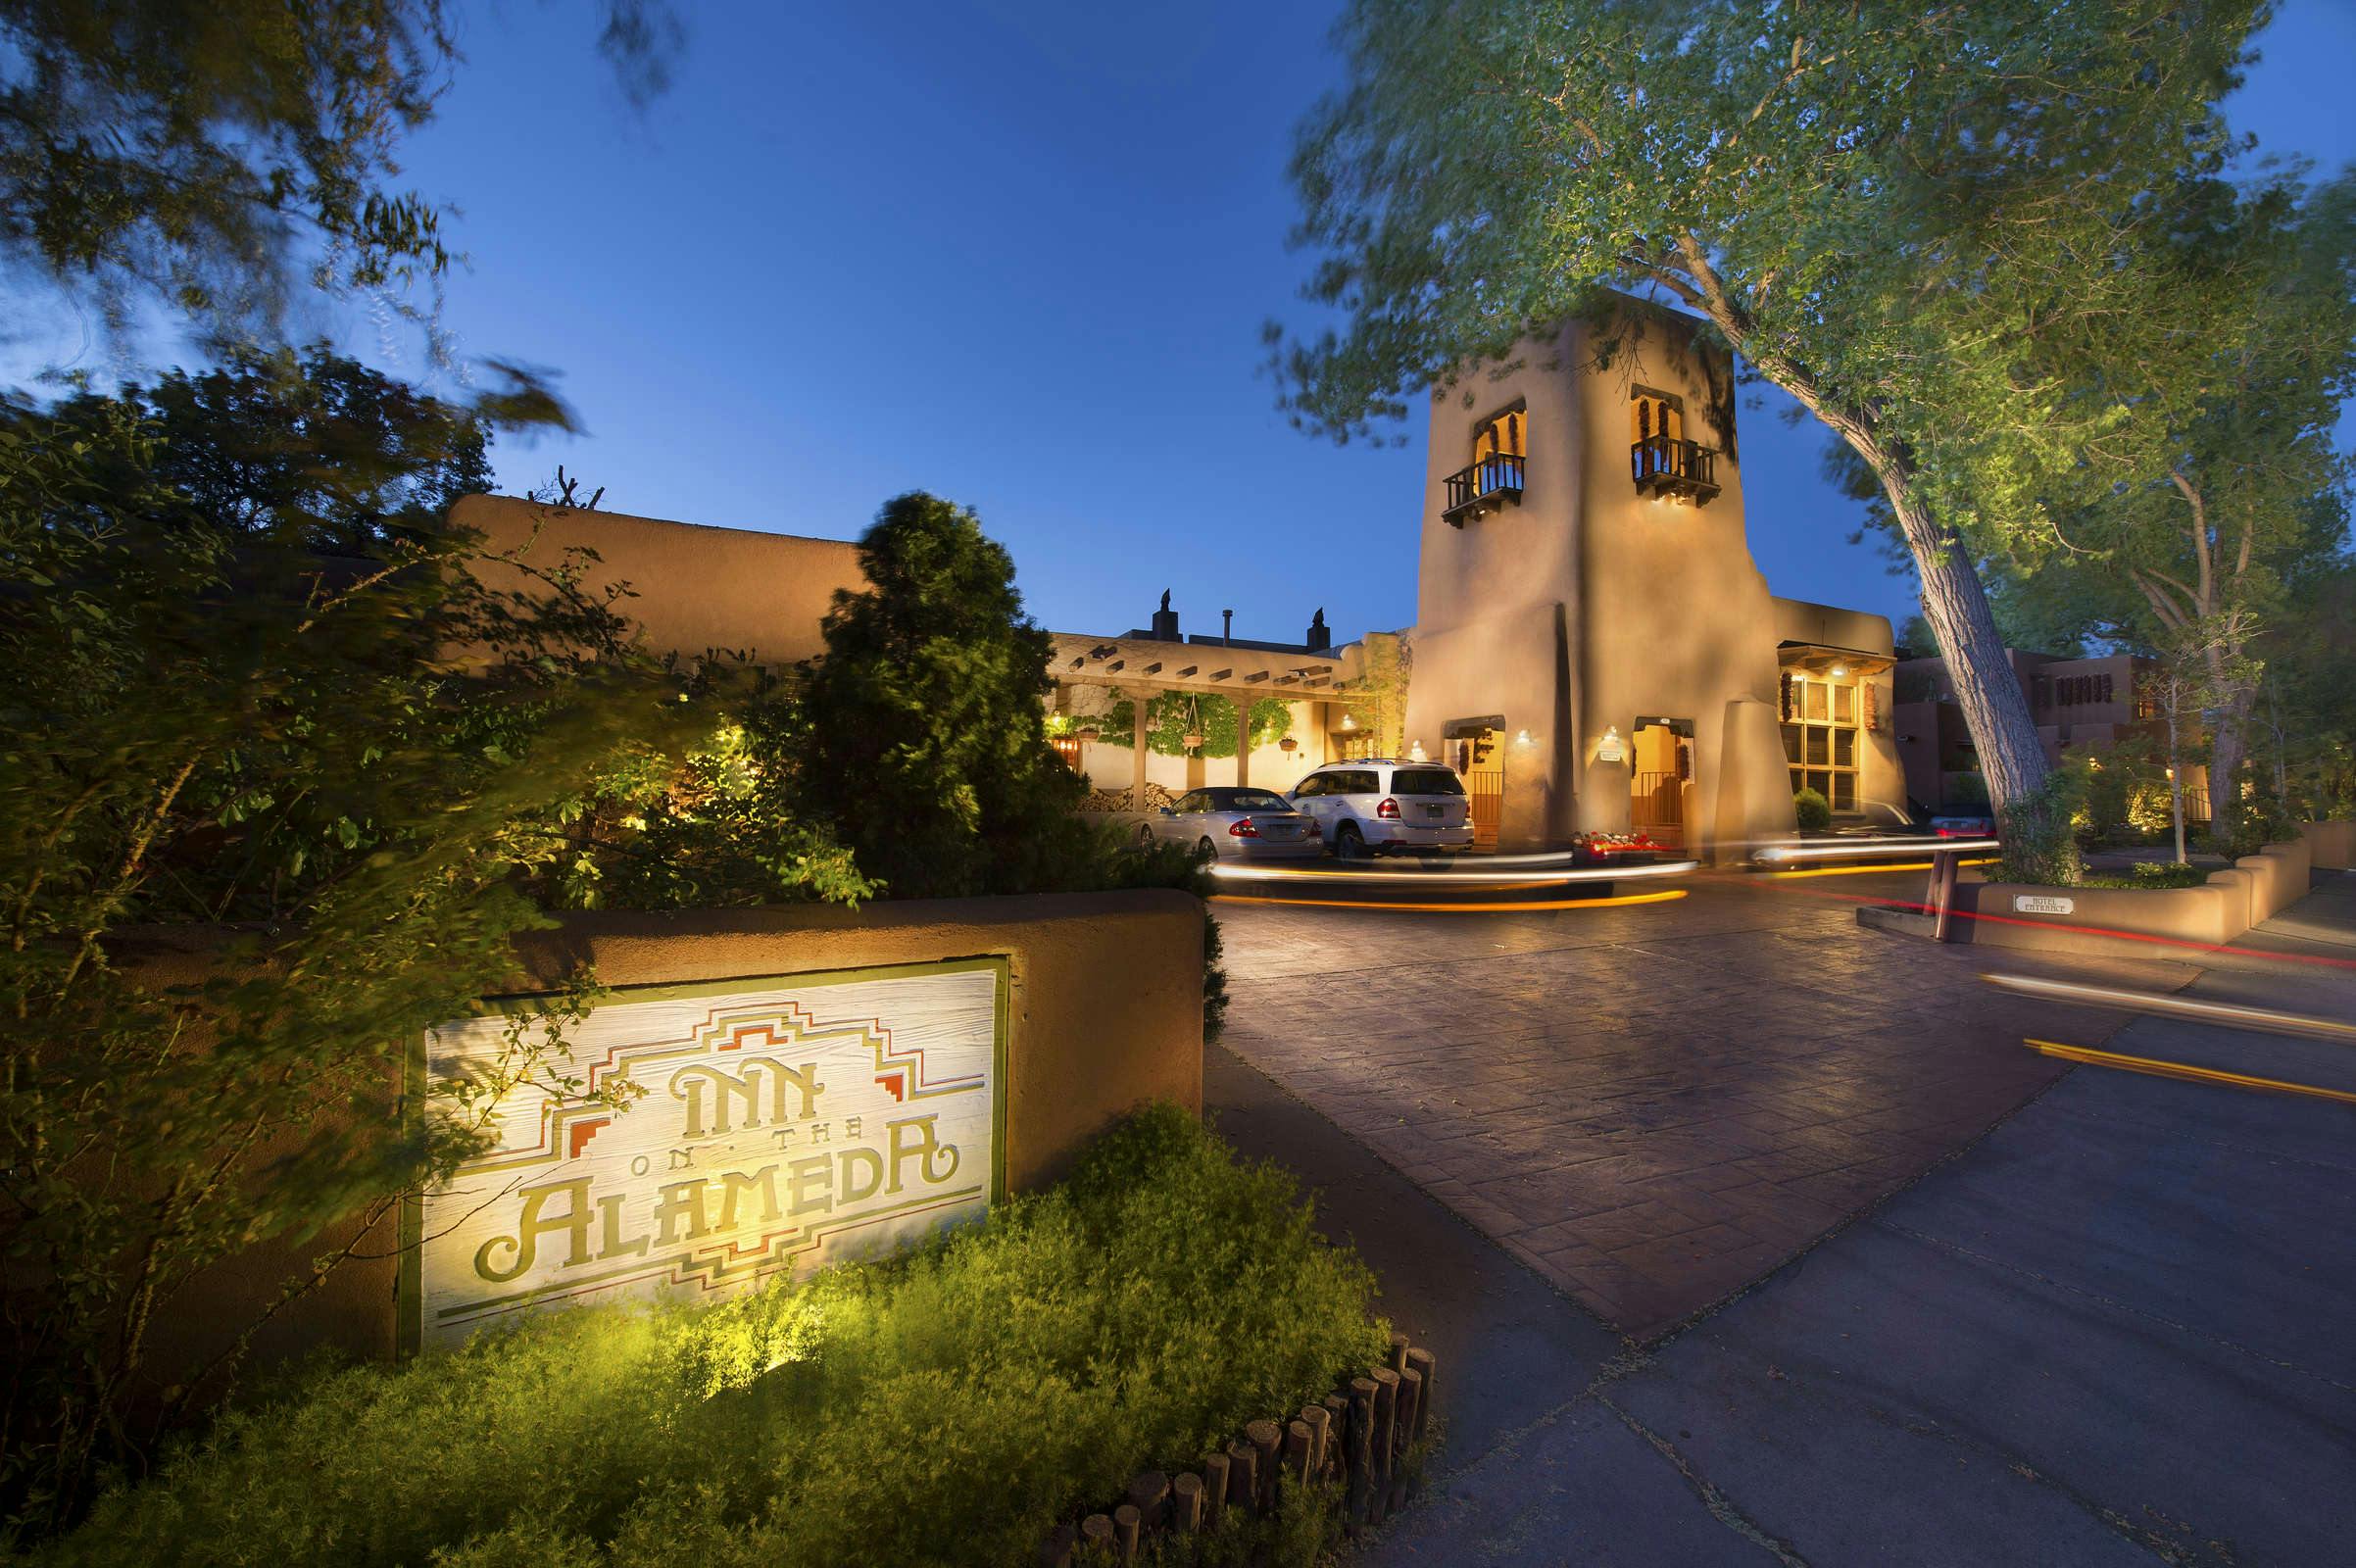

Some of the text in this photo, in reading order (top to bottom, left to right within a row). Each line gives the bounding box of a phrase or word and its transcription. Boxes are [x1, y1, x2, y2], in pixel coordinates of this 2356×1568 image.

[2025, 904, 2065, 912] ENTRANCE
[2033, 897, 2055, 906] HOTEL
[669, 1056, 825, 1139] INN
[630, 1115, 861, 1177] ON THE
[473, 1113, 960, 1283] ALAMEDA
